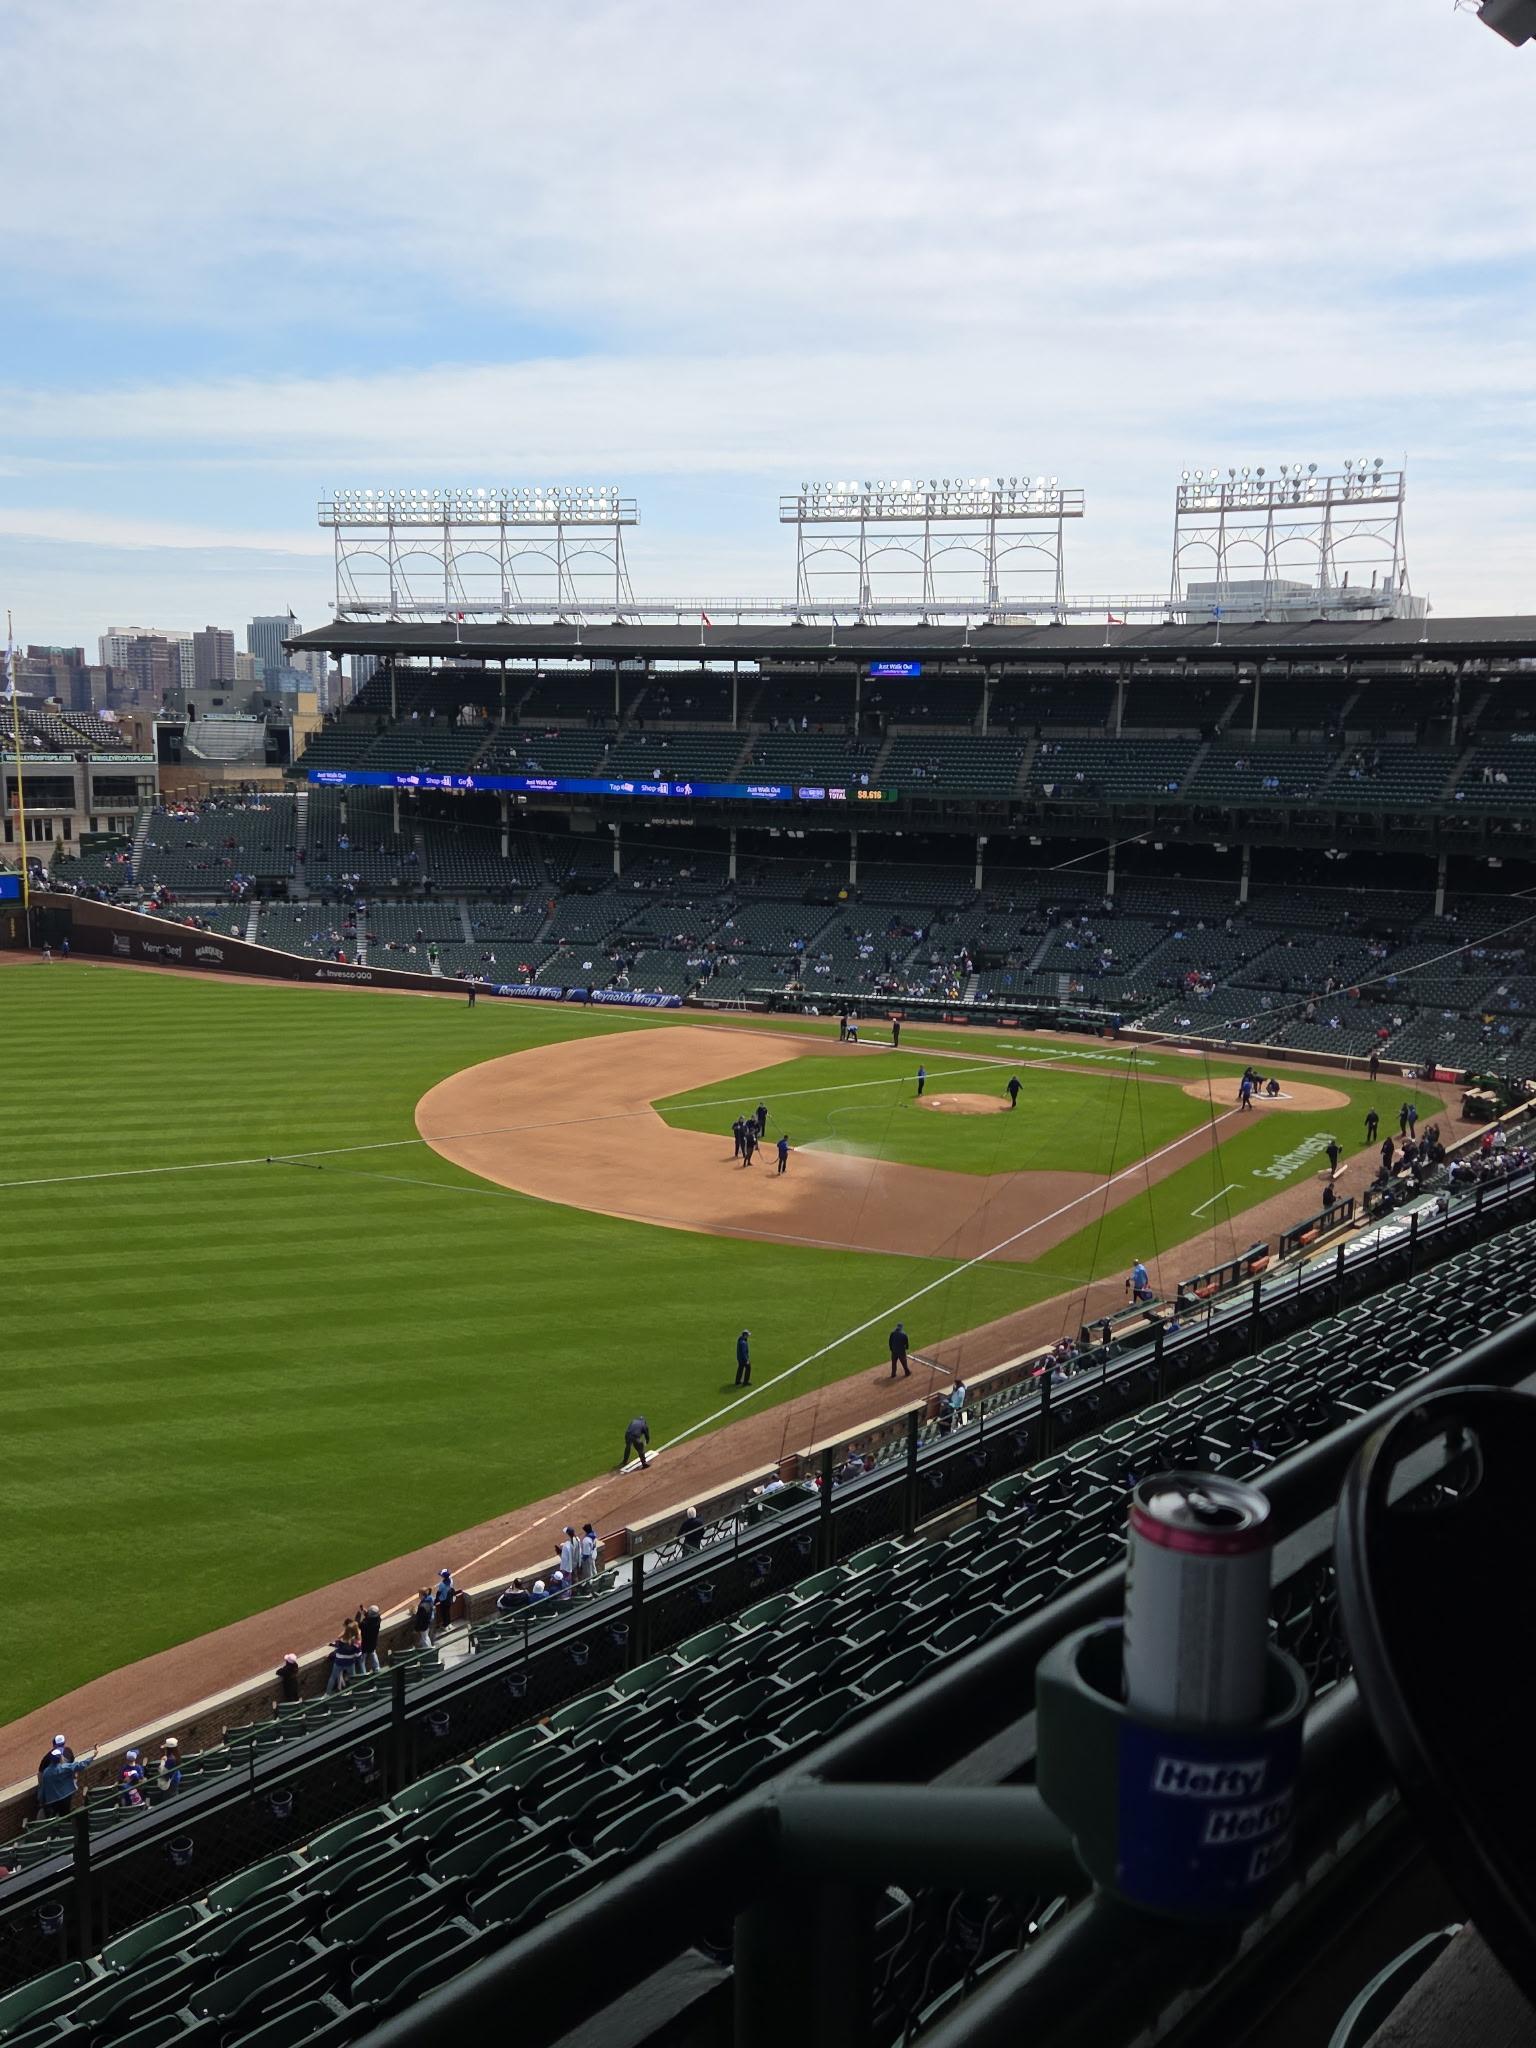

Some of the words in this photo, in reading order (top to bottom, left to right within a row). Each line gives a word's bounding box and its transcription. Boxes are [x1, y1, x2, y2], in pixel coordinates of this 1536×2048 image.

[396, 776, 406, 785] Tap
[426, 777, 440, 785] Shop
[609, 783, 620, 791] Tap
[641, 784, 656, 793] Shop
[195, 945, 224, 960] MARQUEE
[326, 969, 355, 979] Invesco
[498, 985, 538, 998] Reynolds
[538, 987, 562, 999] Wrap
[591, 990, 632, 1002] Reynolds
[632, 993, 658, 1006] Wrap
[1162, 1765, 1261, 1792] Hefty
